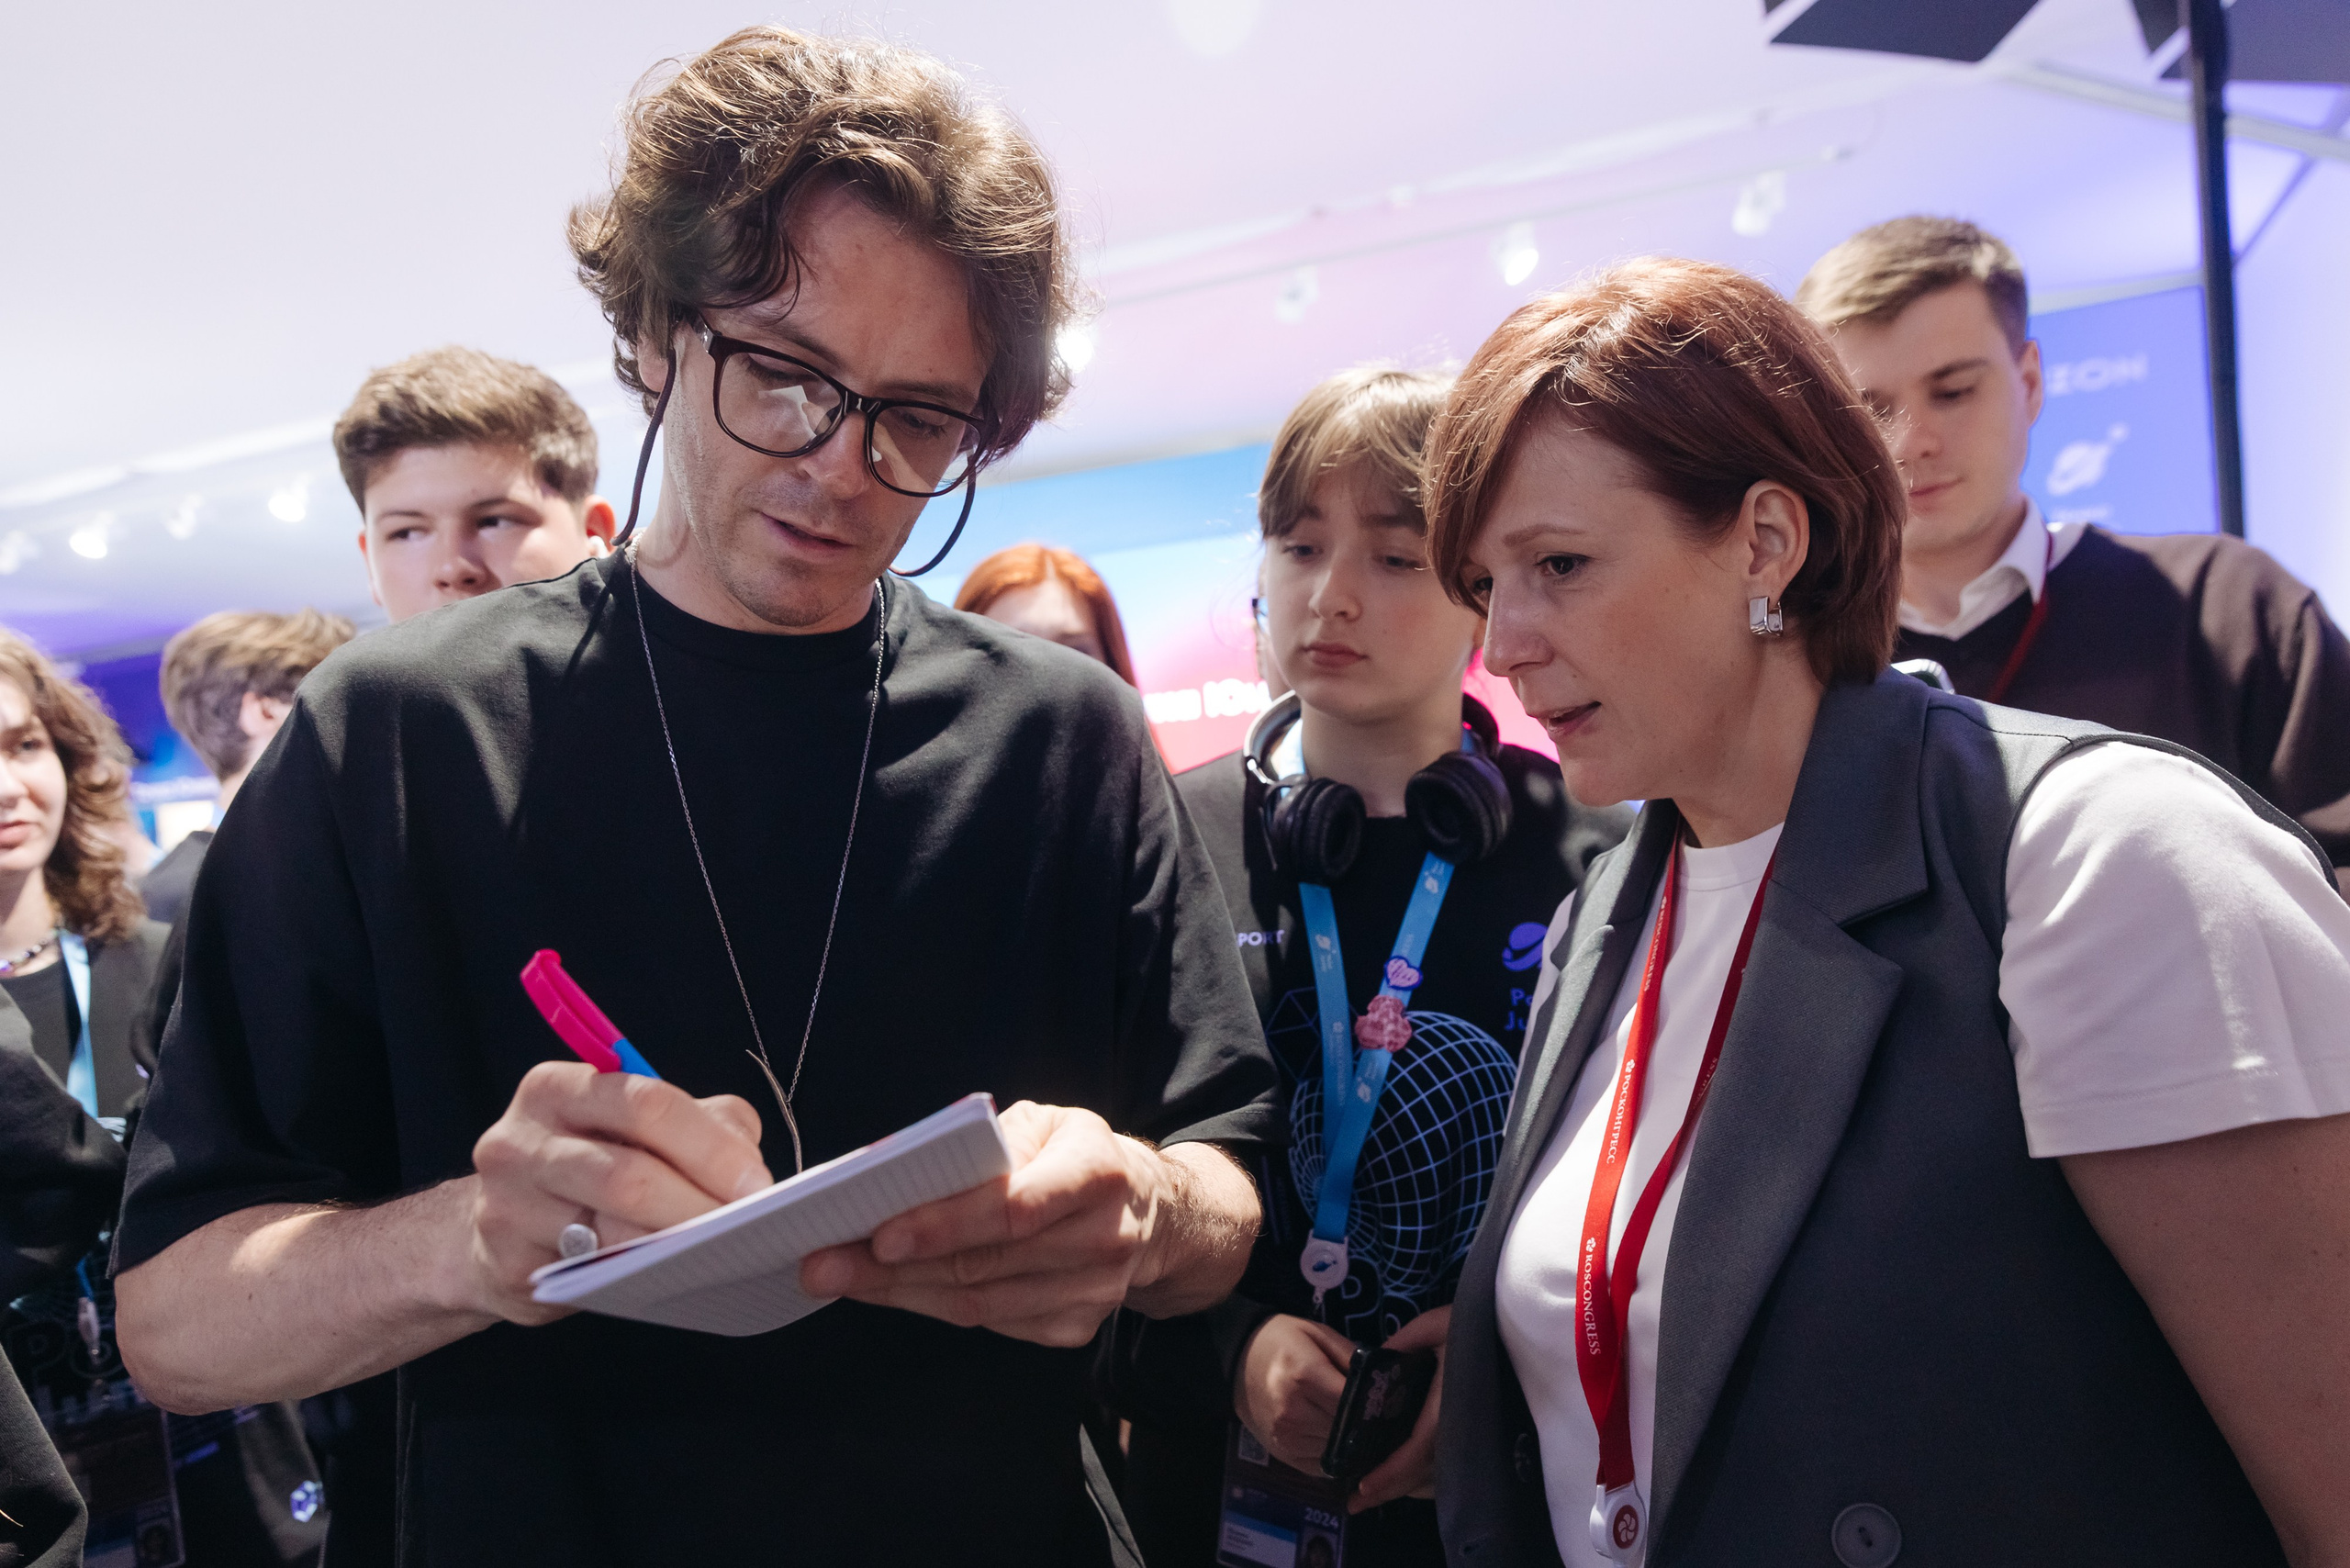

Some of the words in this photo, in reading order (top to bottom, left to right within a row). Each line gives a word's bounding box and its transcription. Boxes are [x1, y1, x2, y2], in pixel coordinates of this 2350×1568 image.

[1606, 1073, 1631, 1164] РОСКОНГРЕСС
[1583, 1254, 1601, 1355] ROSCONGRESS
[1304, 1506, 1339, 1529] 2024
